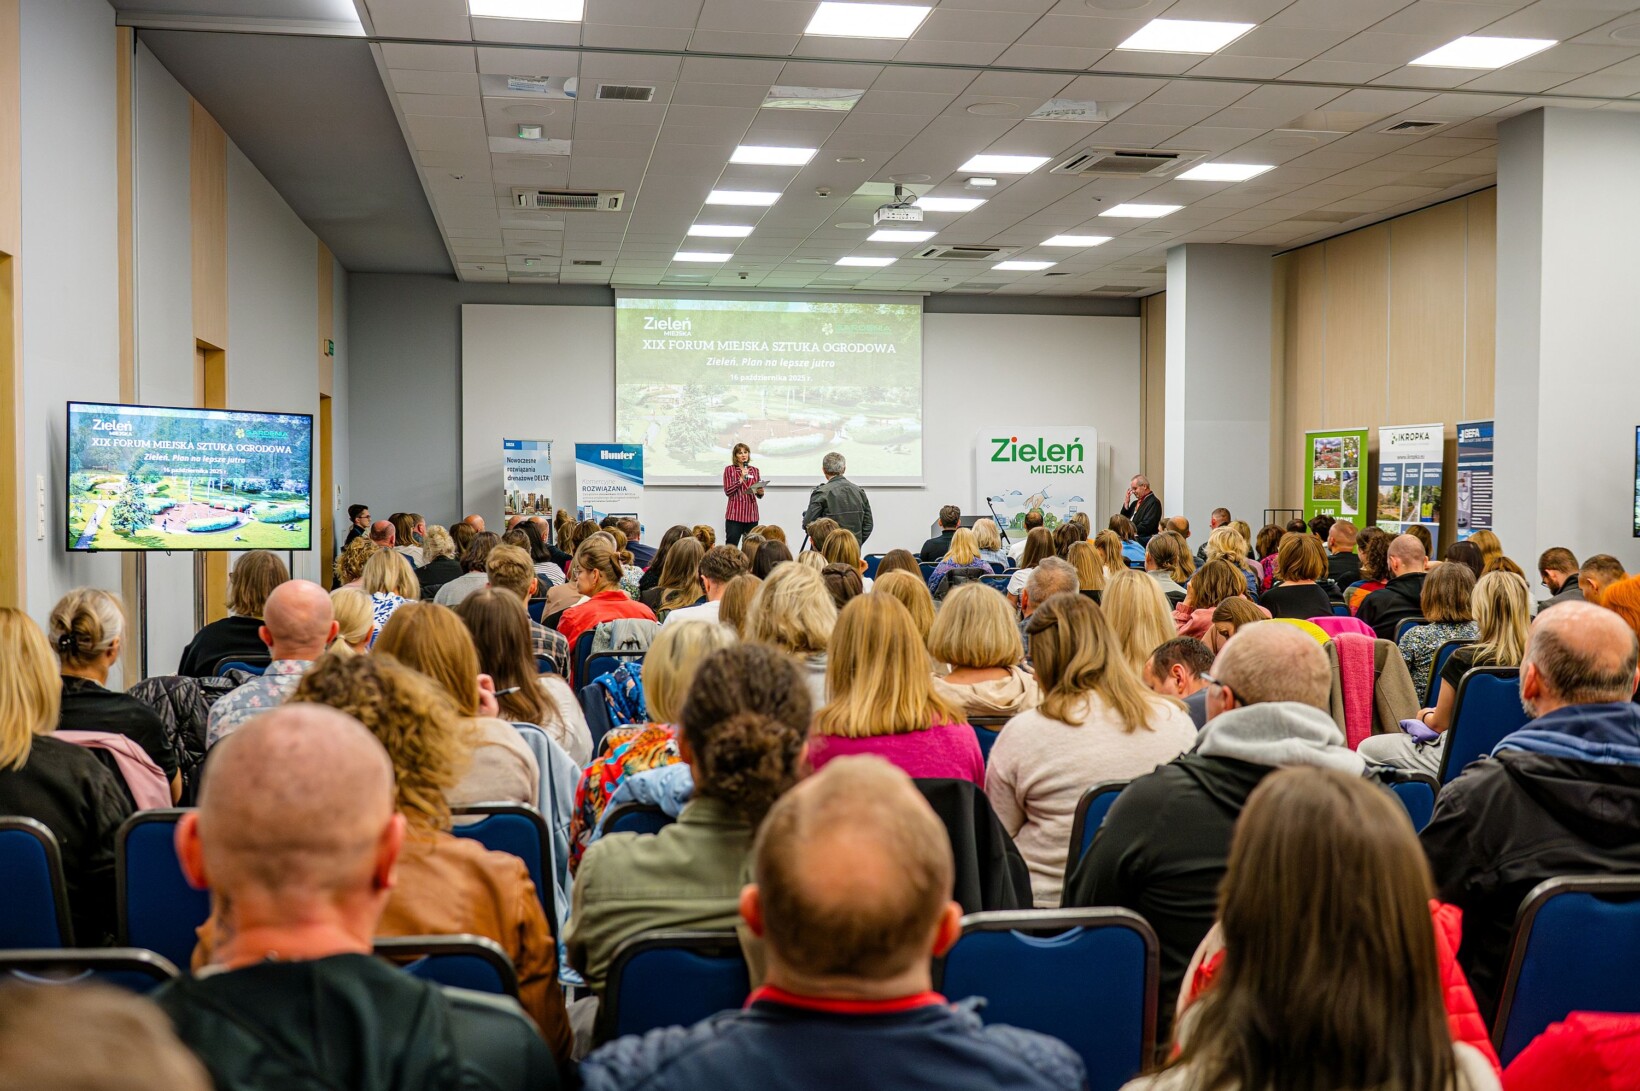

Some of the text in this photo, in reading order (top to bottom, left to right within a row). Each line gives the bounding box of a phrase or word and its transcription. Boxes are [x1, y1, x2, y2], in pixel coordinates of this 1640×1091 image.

[644, 317, 691, 330] Zieleń
[642, 340, 896, 354] XIX FORUM MIEJSKA SZTUKA OGRODOWA
[706, 357, 738, 366] Zieleń.
[742, 358, 762, 366] Plan
[780, 358, 810, 368] lepsze
[811, 358, 836, 369] jutro
[92, 419, 132, 432] Zieleń
[1399, 432, 1430, 442] IKROPKA
[1464, 428, 1480, 438] GEFA
[92, 438, 292, 454] XIX FORUM MIEJSKA SZTUKA OGRODOWA
[991, 436, 1084, 462] Zieleń
[202, 455, 226, 464] lepsze
[226, 456, 246, 464] jutro
[601, 450, 634, 460] Hunter
[1030, 464, 1084, 474] MIEJSKA
